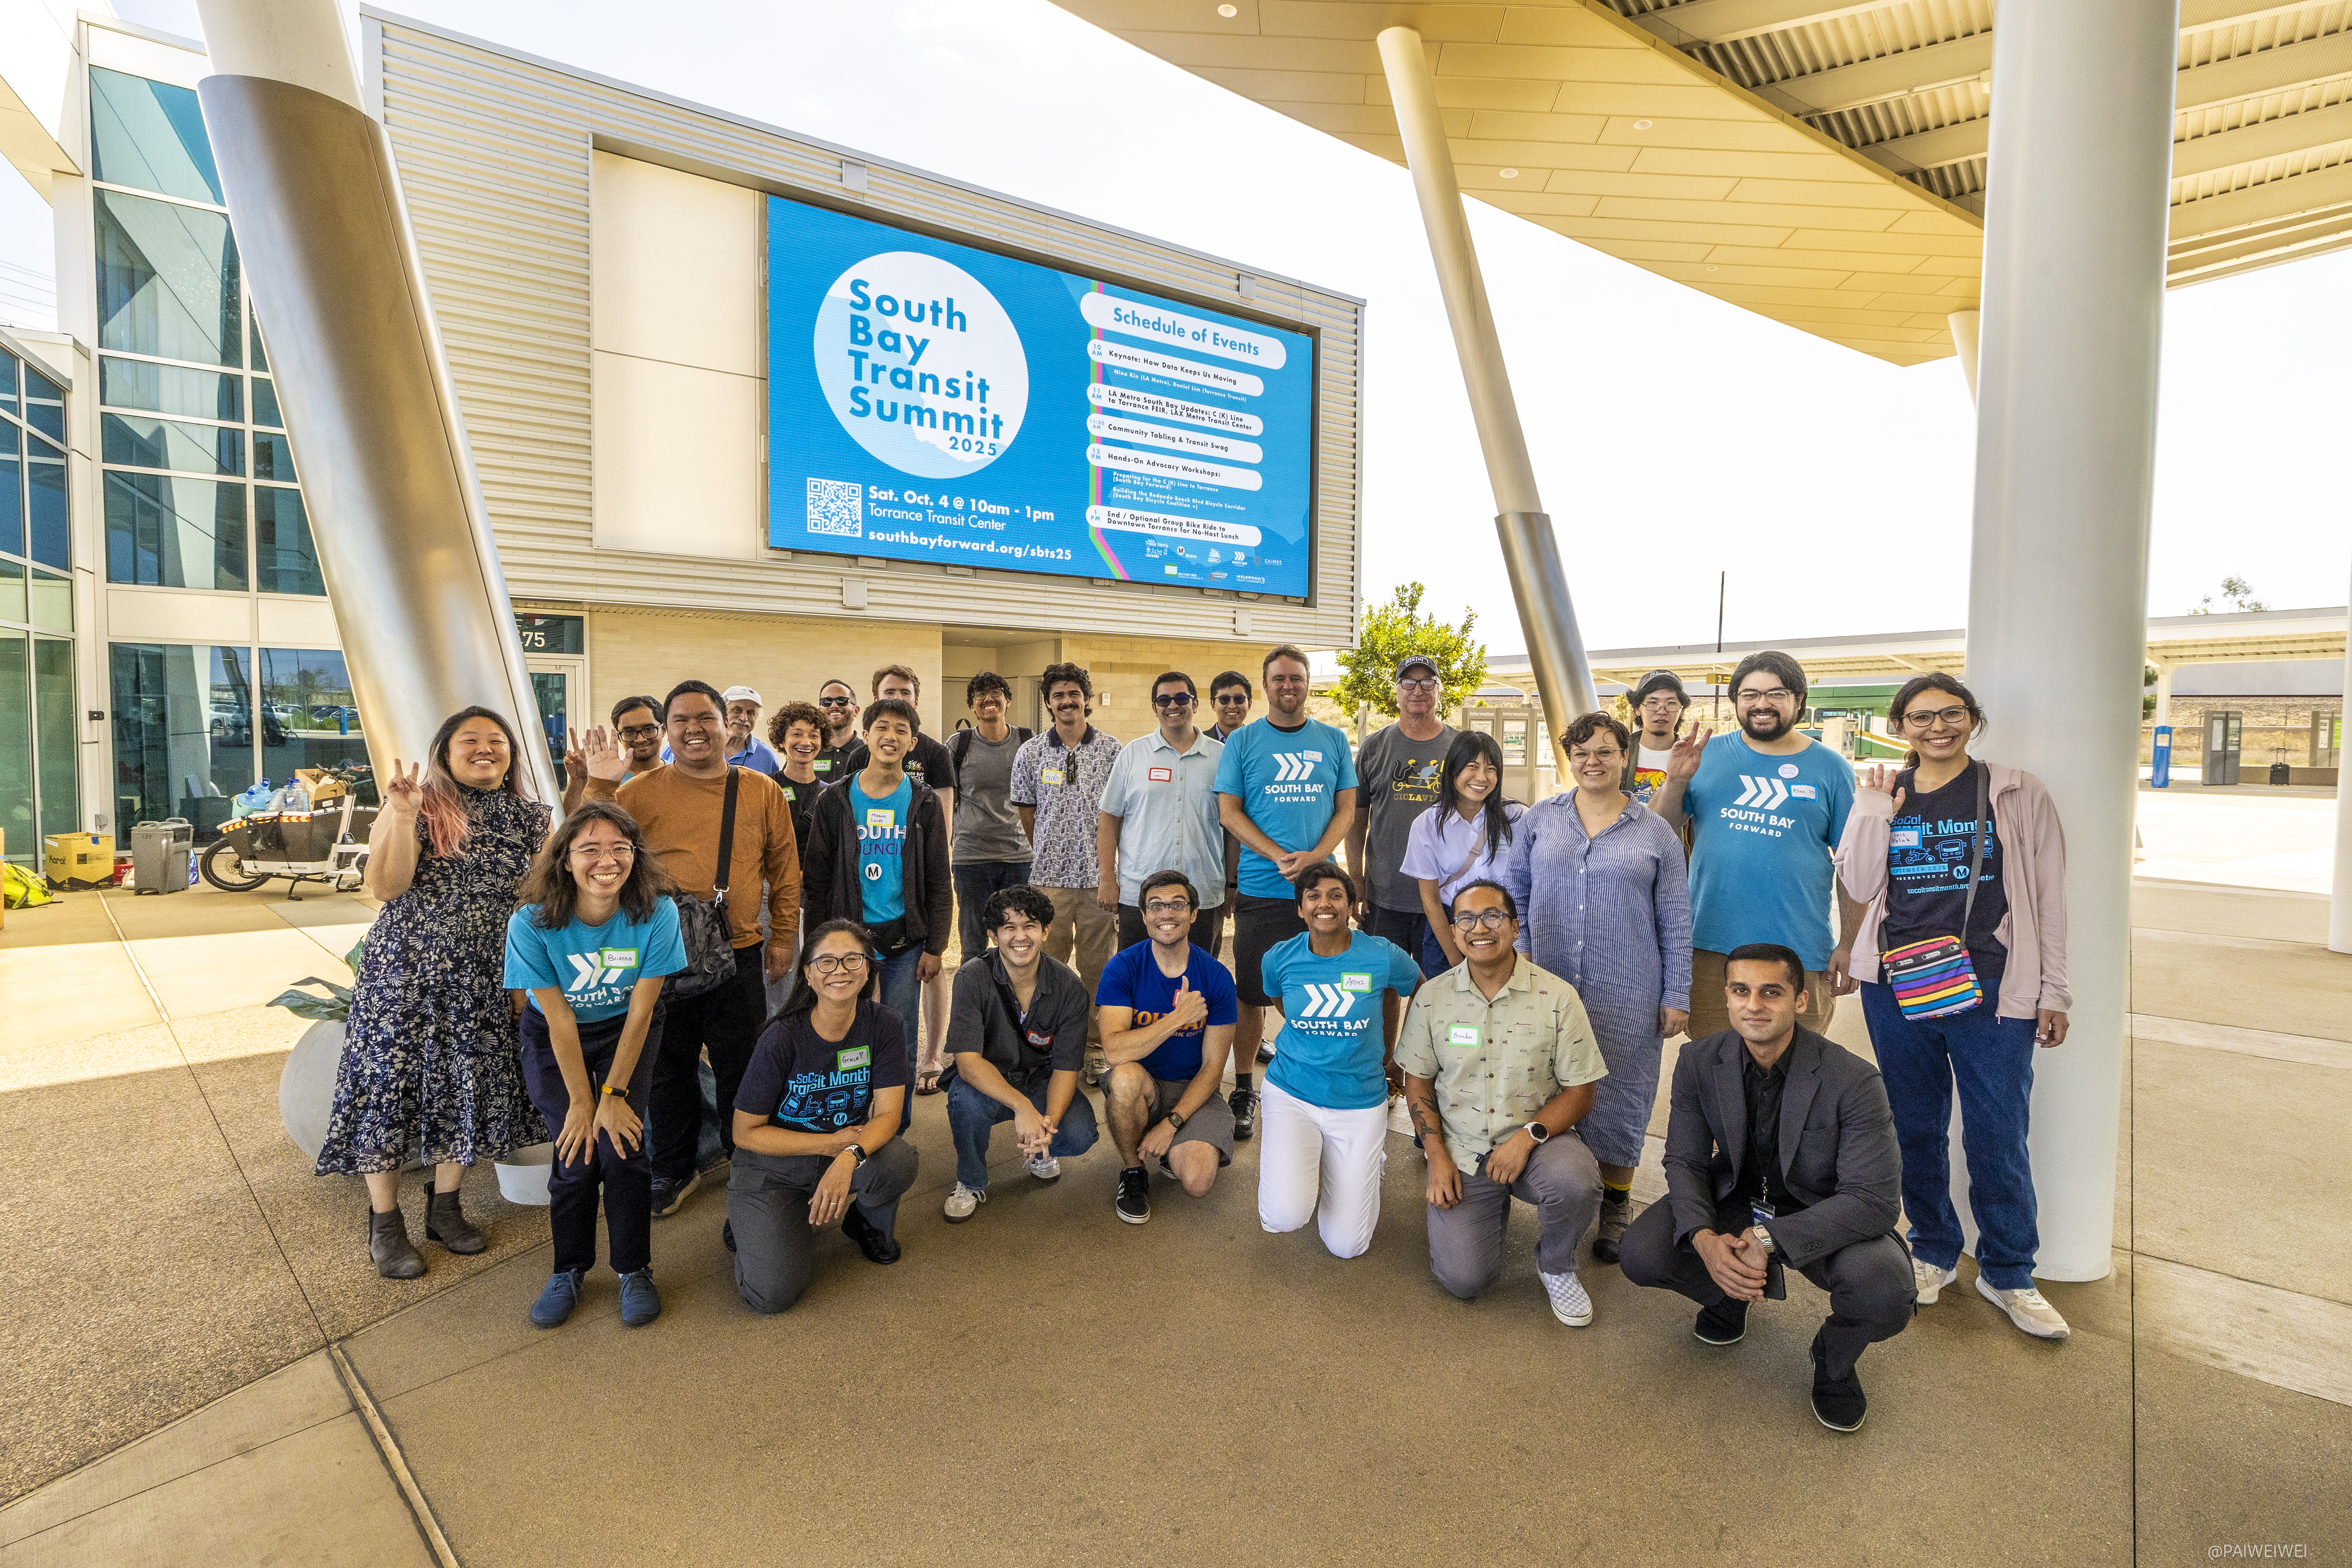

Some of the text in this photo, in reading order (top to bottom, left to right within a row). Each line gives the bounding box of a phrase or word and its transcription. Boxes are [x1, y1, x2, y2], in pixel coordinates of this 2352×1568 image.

[849, 279, 966, 333] South
[1114, 307, 1259, 355] Schedule of Events
[850, 314, 930, 366] Bay
[1109, 350, 1140, 362] Keynote:
[1163, 362, 1177, 371] Data
[1181, 366, 1200, 376] Keeps
[1213, 374, 1236, 385] Moving
[848, 349, 990, 404] Transit
[1152, 377, 1171, 386] Metro),
[1202, 388, 1226, 397] (Torrance
[1227, 394, 1246, 402] Transit)
[849, 386, 1003, 439] Summit
[1118, 399, 1148, 410] Torrance
[1152, 405, 1167, 415] FEIR,
[1208, 417, 1229, 426] Transit
[1120, 393, 1140, 401] Metro
[1144, 397, 1163, 405] South
[1166, 402, 1178, 410] Bay
[1181, 404, 1210, 415] Updates:
[1219, 412, 1227, 421] (K)
[949, 436, 997, 456] 2025
[1108, 424, 1148, 437] Community
[1151, 432, 1175, 442] Tabling
[1186, 438, 1208, 447] Transit
[1211, 443, 1228, 452] Swag
[1108, 453, 1220, 477] Hands-On Advocacy Workshops:
[1113, 472, 1140, 481] Preparing
[1113, 487, 1136, 496] Building
[1146, 481, 1170, 490] Forward)
[869, 486, 898, 502] Sat.
[904, 491, 933, 506] Oct.
[938, 495, 948, 508] 4
[953, 497, 964, 509] @
[970, 499, 1009, 515] 10am
[1025, 506, 1054, 521] 1pm
[869, 503, 1006, 530] Torrance Transit Center
[1108, 518, 1145, 528] Downtown
[1148, 523, 1177, 532] Torrance
[1130, 514, 1159, 523] Optional
[1163, 518, 1183, 527] Group
[869, 530, 1071, 560] southbayforward.org/sbts25
[519, 631, 545, 647] 75
[1265, 785, 1301, 794] SOUTH
[1721, 807, 1795, 829] SOUTH BAY
[1891, 815, 1921, 826] SoCal
[857, 825, 907, 840] OUTH
[1729, 823, 1782, 837] FORWARD
[863, 843, 902, 855] UNCI
[869, 867, 878, 876] M
[1957, 868, 1967, 877] M
[564, 987, 607, 1001] OUTH
[1291, 1018, 1370, 1030] SOUTH BAY
[796, 1071, 822, 1084] SoC
[830, 1067, 870, 1086] Month
[835, 1115, 845, 1123] M
